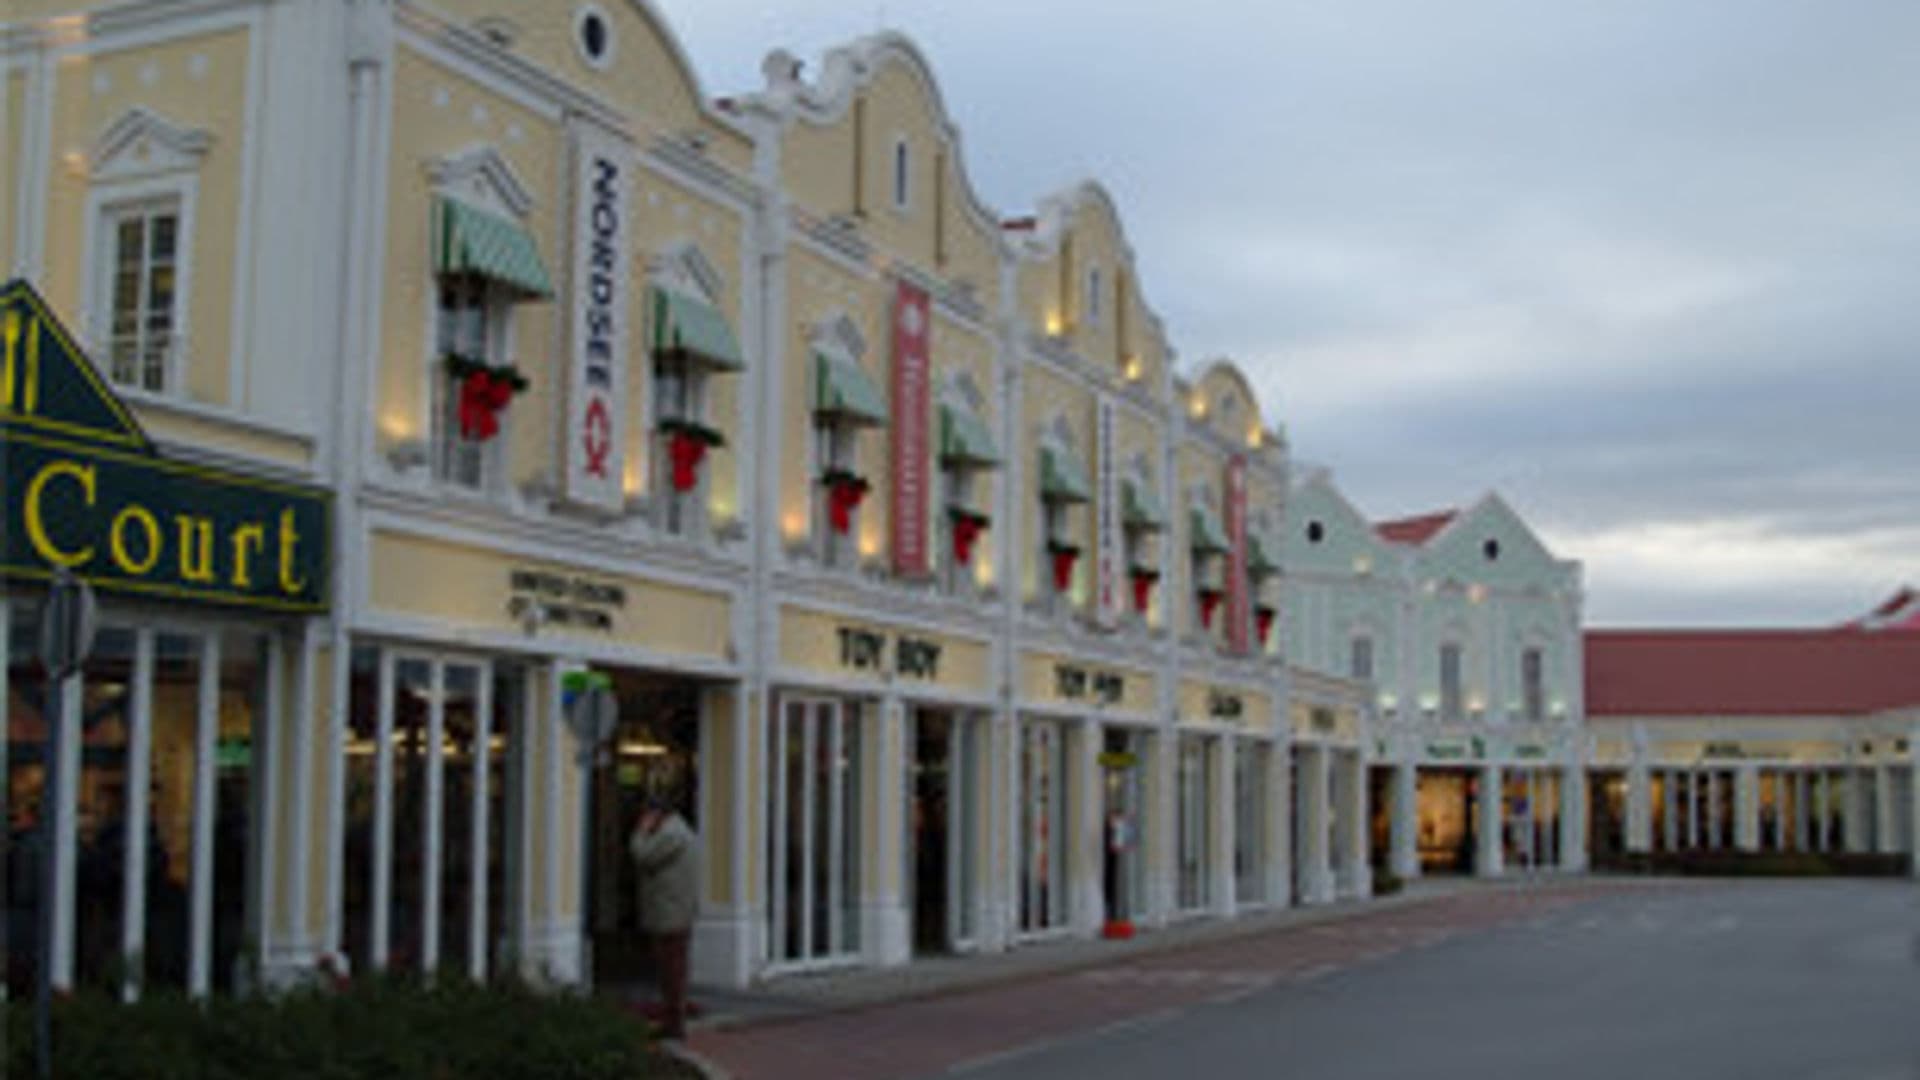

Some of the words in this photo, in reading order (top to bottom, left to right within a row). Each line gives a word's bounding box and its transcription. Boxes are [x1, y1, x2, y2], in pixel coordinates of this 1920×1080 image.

[586, 157, 618, 390] NORDSEE
[24, 459, 306, 594] Court
[836, 625, 886, 668] TOY
